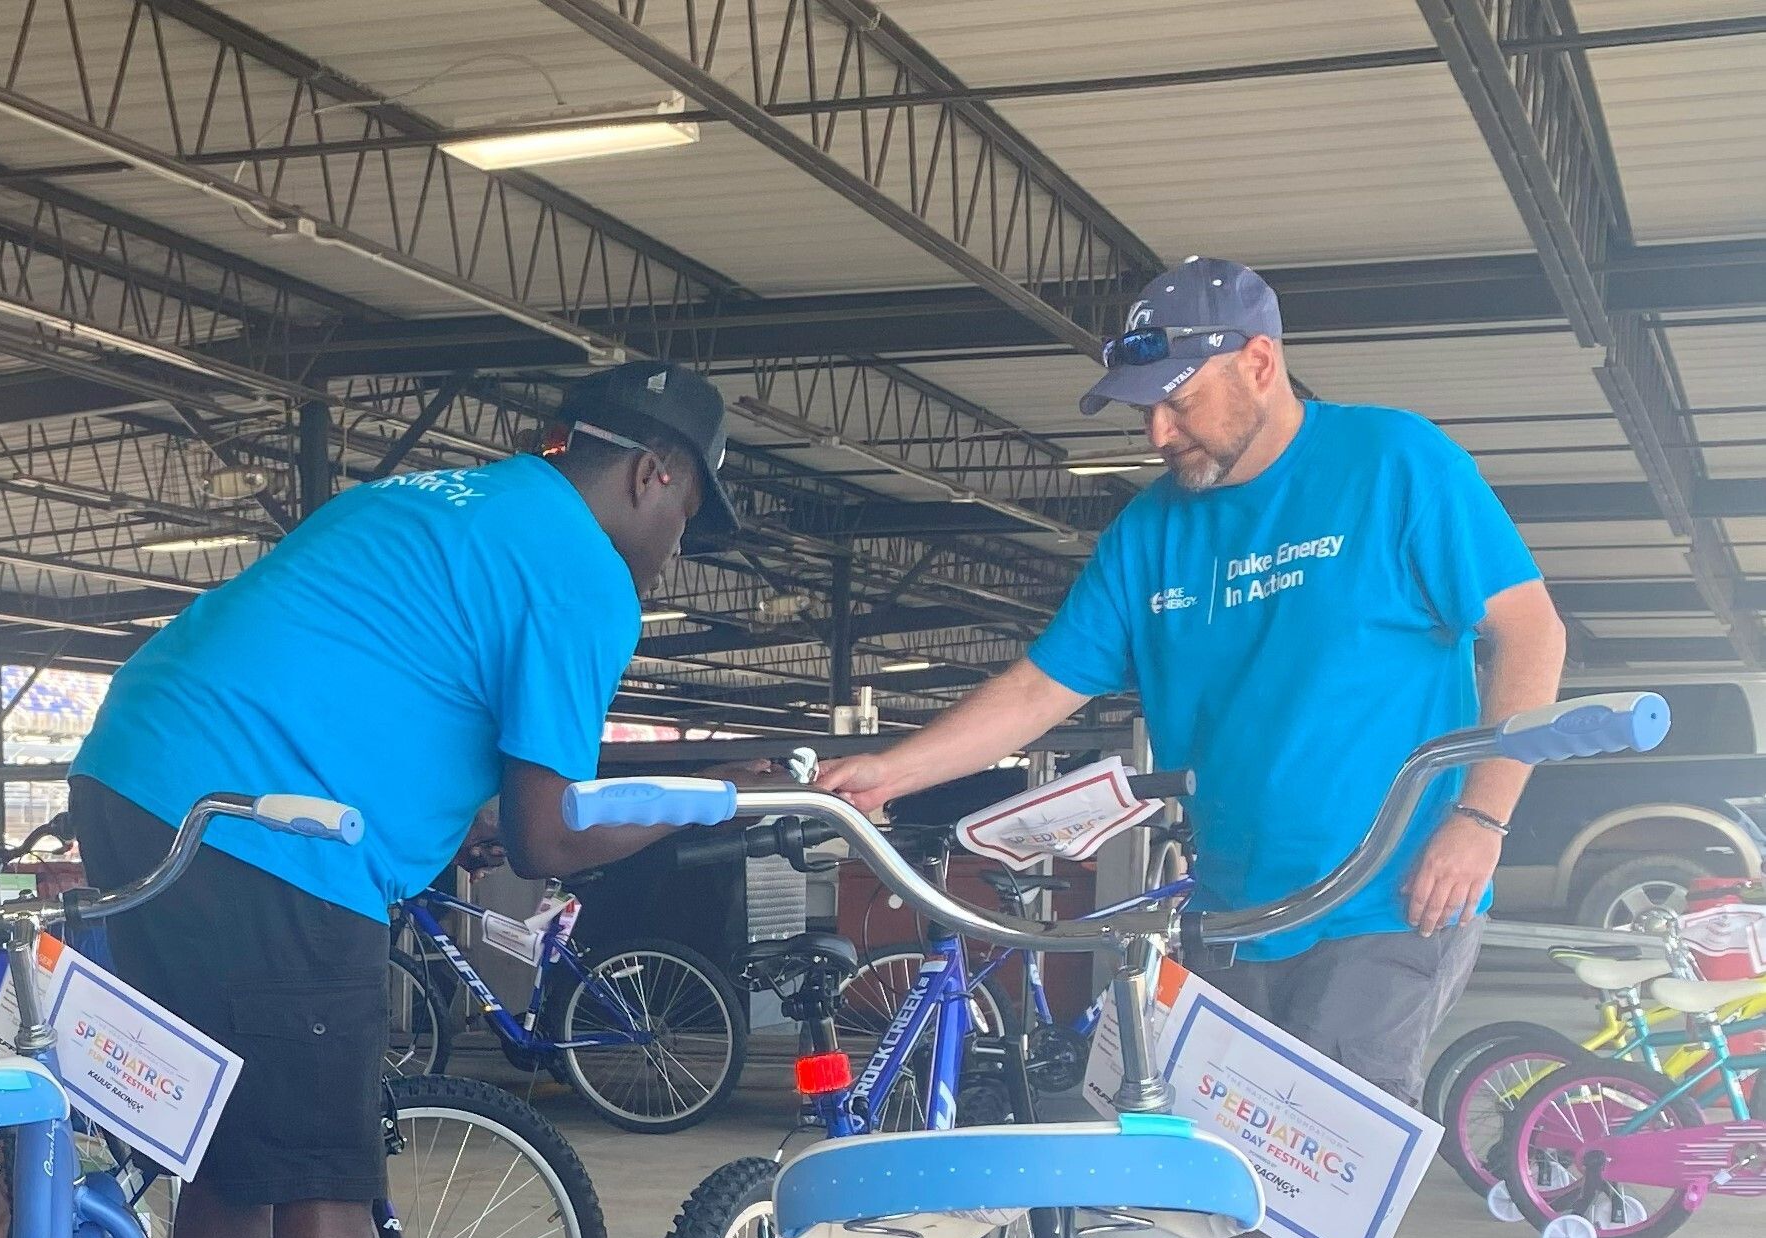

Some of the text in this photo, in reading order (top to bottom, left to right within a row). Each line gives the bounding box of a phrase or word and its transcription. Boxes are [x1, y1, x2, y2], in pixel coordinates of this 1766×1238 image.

[1227, 534, 1345, 581] Duke Energy
[1164, 586, 1185, 599] UKE
[1225, 569, 1305, 608] In Action
[433, 934, 503, 1012] HUFFY
[75, 1020, 185, 1101] SPEEDIATRICS
[88, 1048, 105, 1064] FUN
[106, 1060, 123, 1075] DAY
[121, 1072, 158, 1102] FESTIVAL
[111, 1086, 140, 1110] RACING
[1198, 1073, 1358, 1183] SPEEDIATRICS
[1215, 1112, 1321, 1183] FUN DAY FESTIVAL
